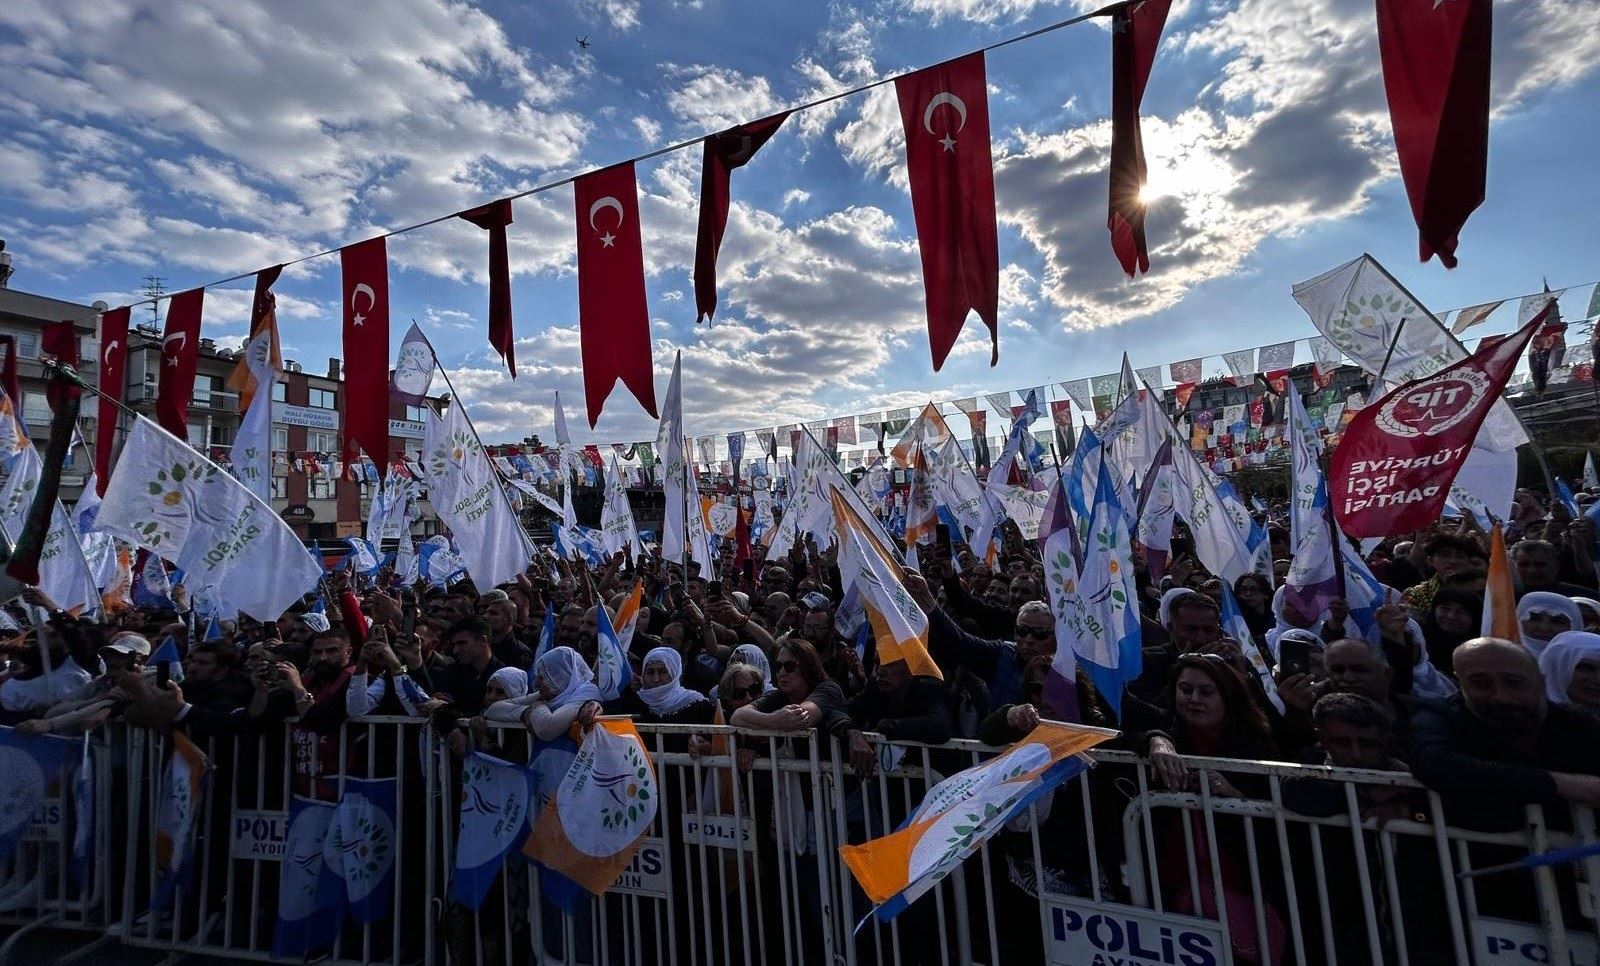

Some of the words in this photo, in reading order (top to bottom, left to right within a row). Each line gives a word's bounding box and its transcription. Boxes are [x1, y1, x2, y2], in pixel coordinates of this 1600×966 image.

[1083, 615, 1103, 640] SOL
[568, 750, 587, 779] PARTİ
[31, 806, 60, 824] LİS
[237, 818, 288, 841] POLİ
[252, 843, 286, 854] AYDI
[615, 875, 642, 888] DIN
[1051, 906, 1217, 966] POLİS
